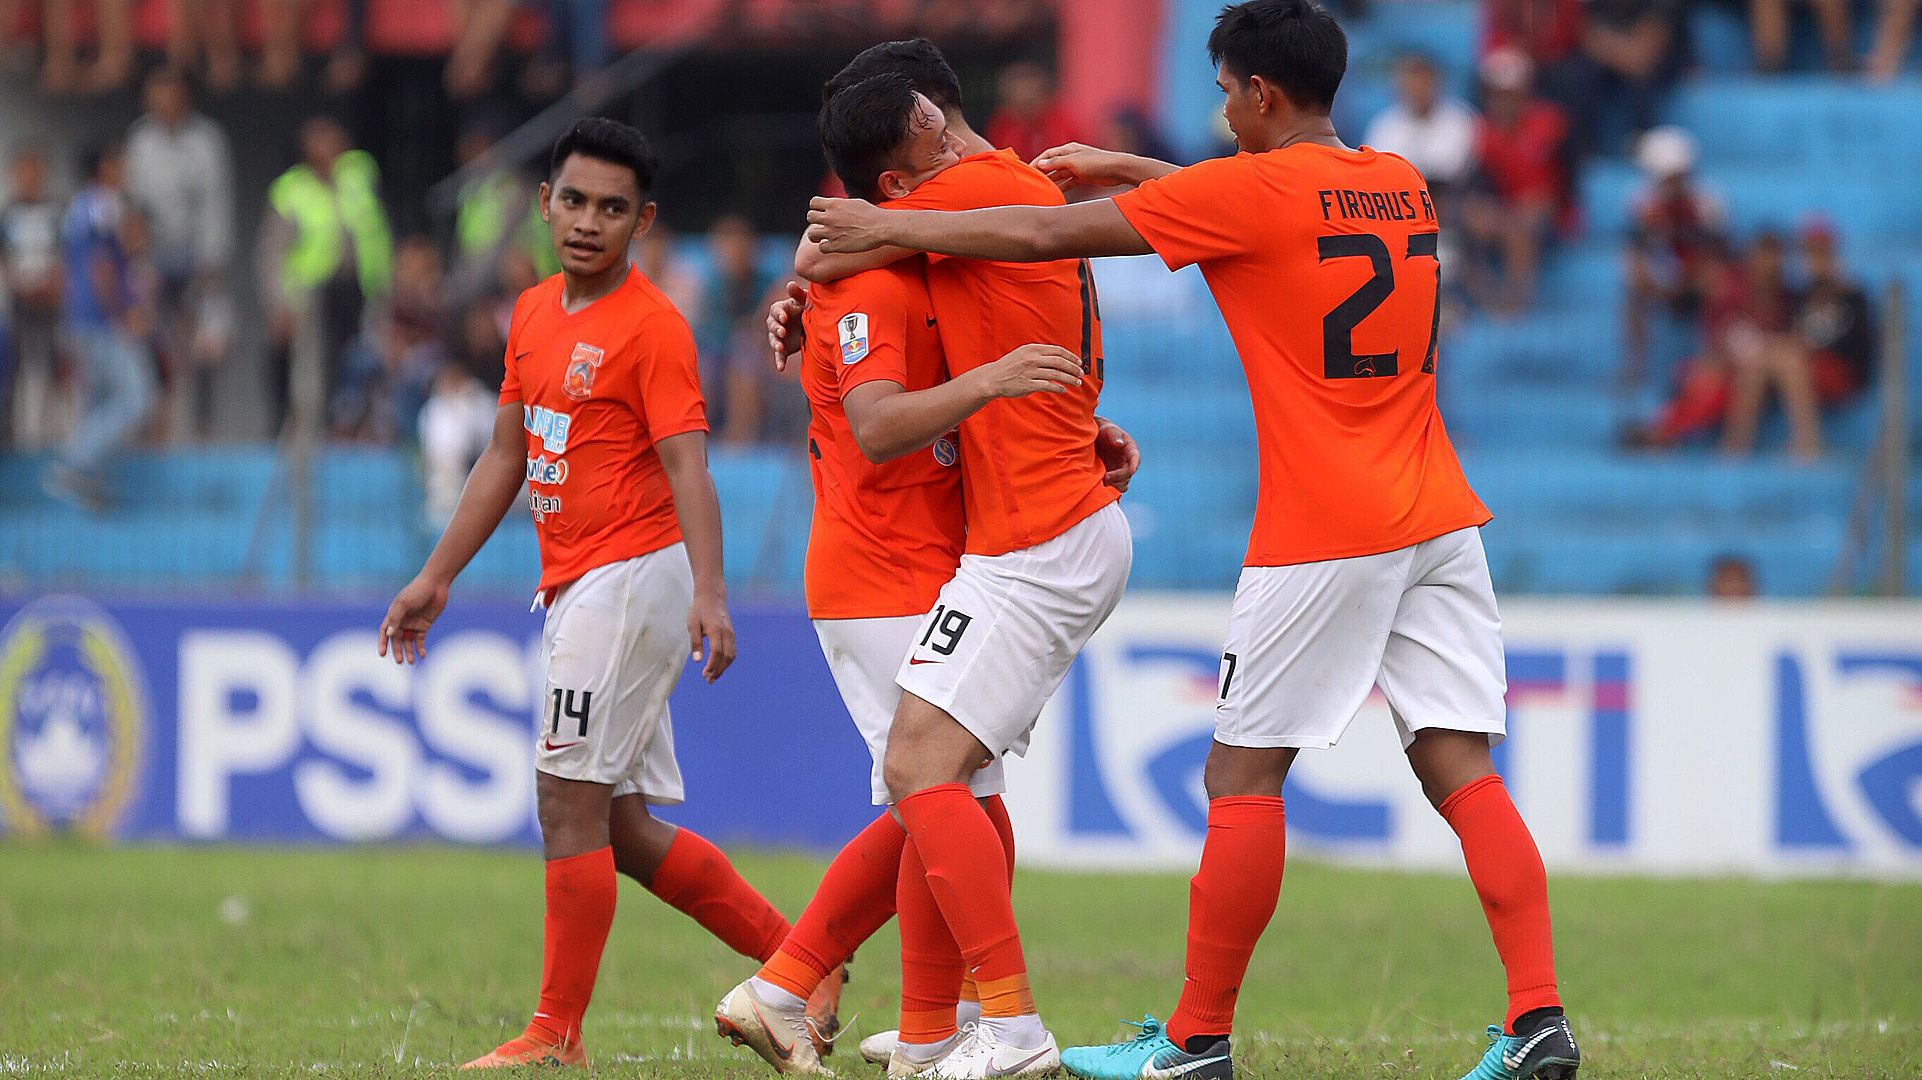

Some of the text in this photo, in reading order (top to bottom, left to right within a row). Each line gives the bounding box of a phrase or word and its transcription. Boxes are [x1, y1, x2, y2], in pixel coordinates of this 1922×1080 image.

[1318, 189, 1416, 221] FIRDAUS
[1317, 232, 1442, 380] 27
[919, 604, 973, 656] 19
[178, 628, 545, 843] PSS
[551, 688, 593, 737] 14
